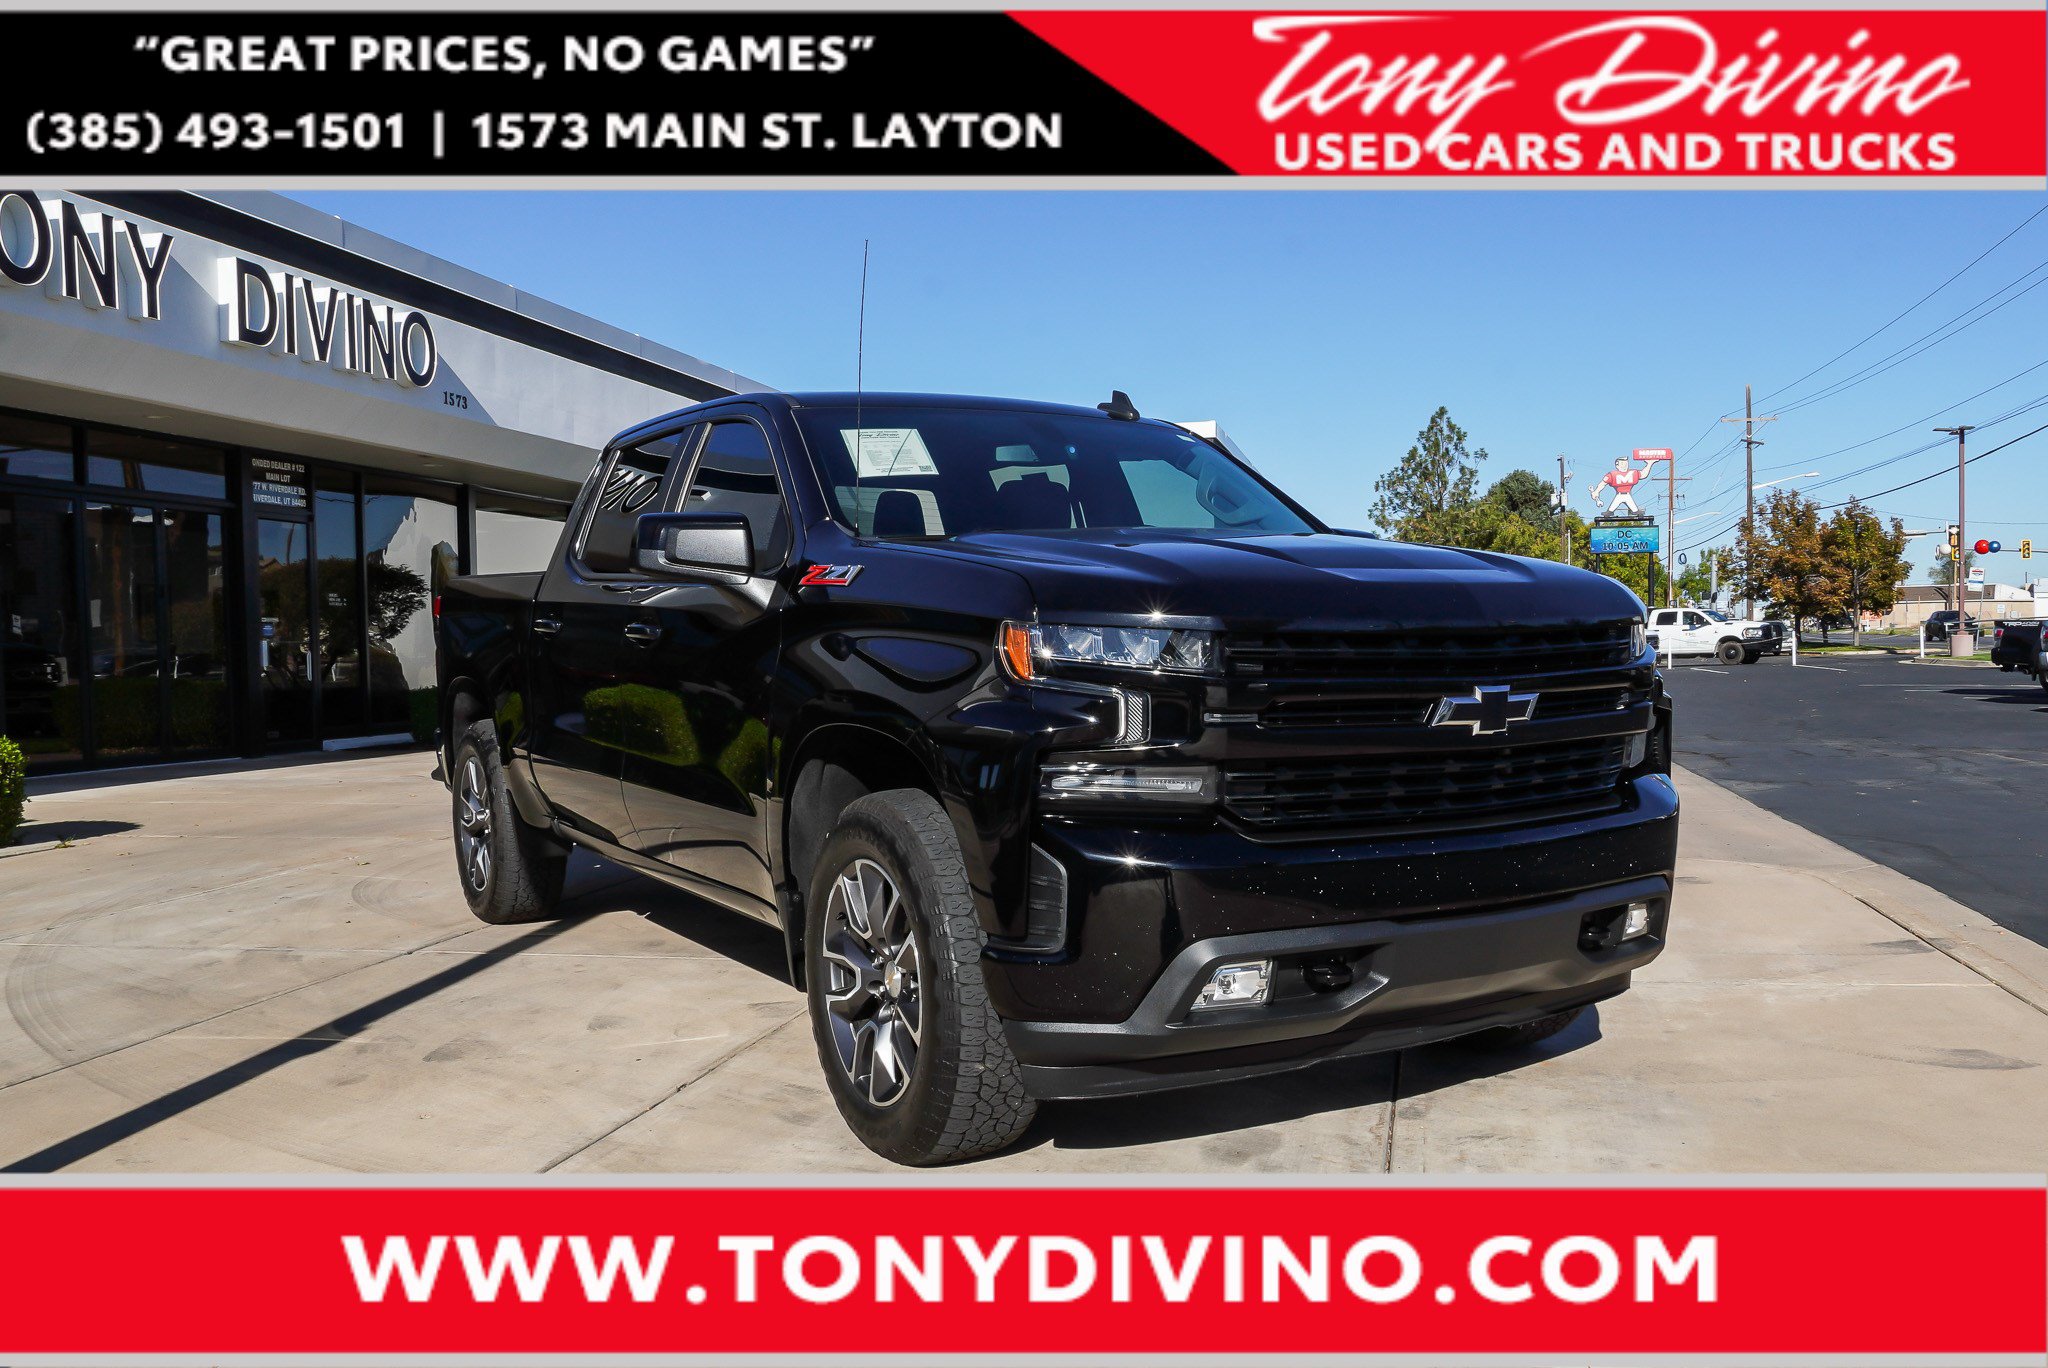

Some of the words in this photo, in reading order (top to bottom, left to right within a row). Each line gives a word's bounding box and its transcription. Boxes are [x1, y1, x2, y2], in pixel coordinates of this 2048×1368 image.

[230, 257, 438, 388] DIVINO
[443, 391, 469, 410] 1573
[270, 460, 291, 471] DEALER
[265, 472, 280, 482] MAIN
[280, 474, 291, 483] LOT
[1616, 470, 1634, 484] M
[268, 483, 298, 495] RIVERDALE
[283, 497, 291, 505] UT
[1617, 530, 1633, 539] DC
[1632, 541, 1649, 550] AM
[799, 564, 864, 587] Z71
